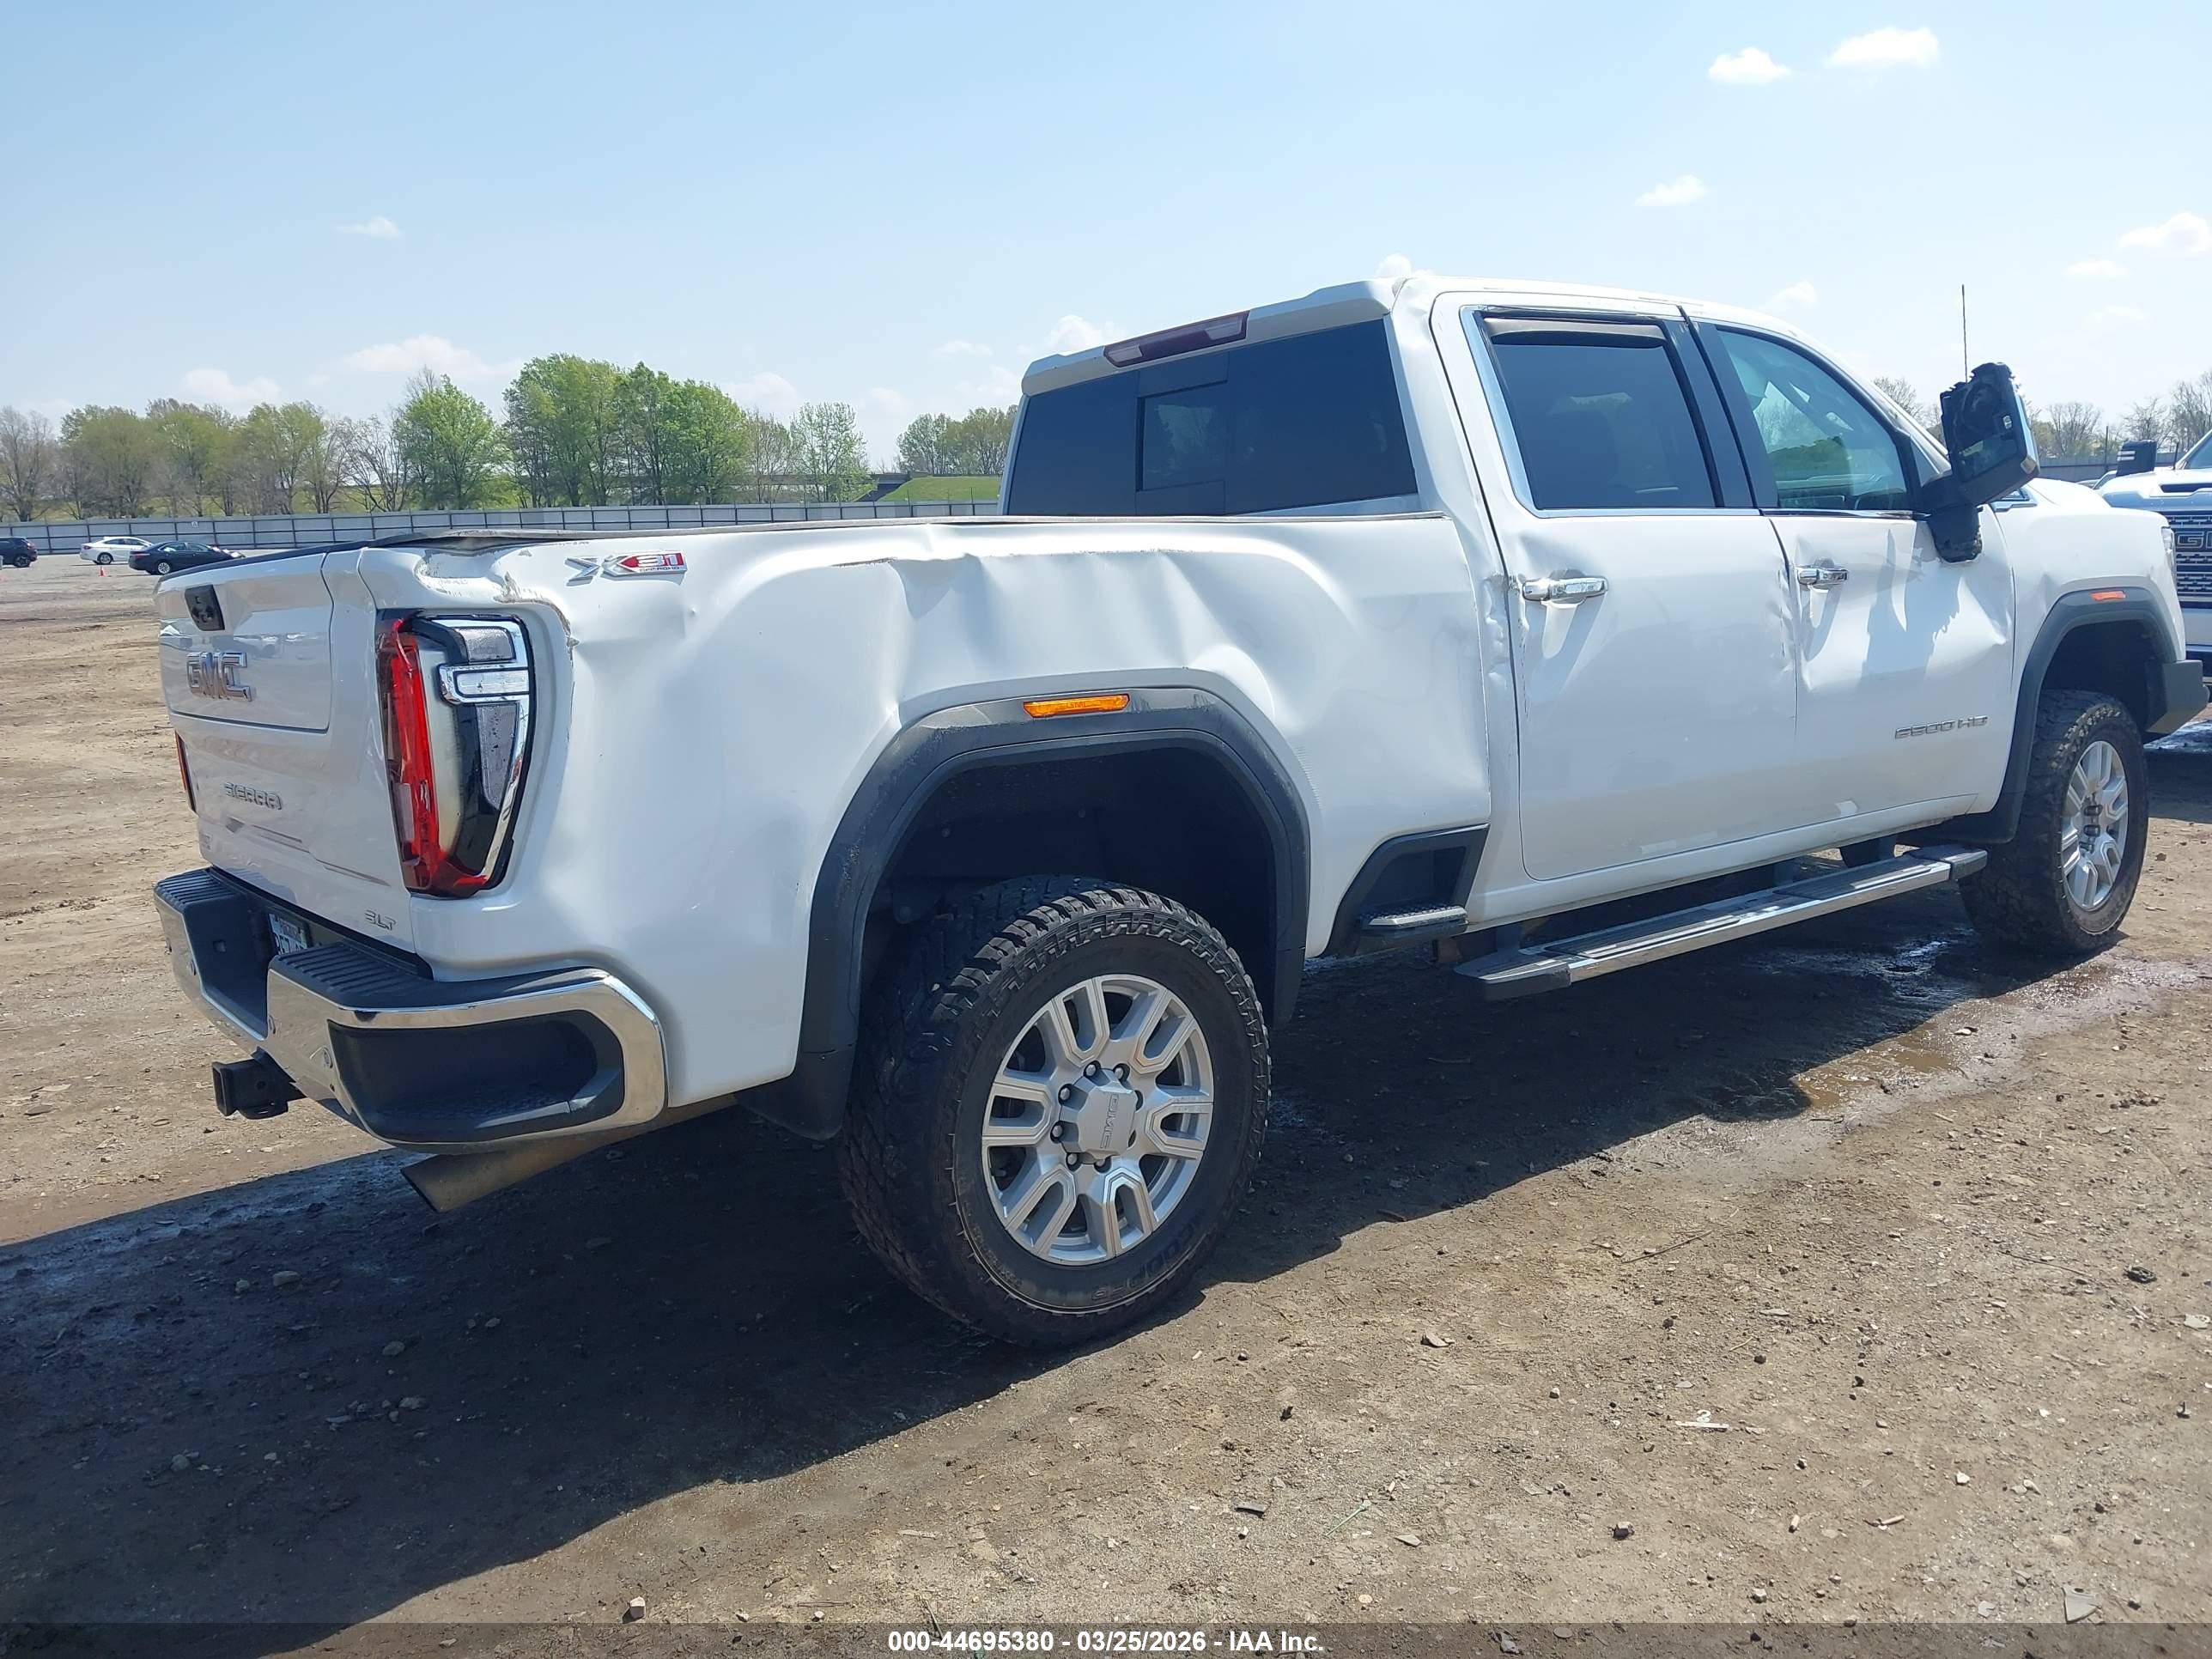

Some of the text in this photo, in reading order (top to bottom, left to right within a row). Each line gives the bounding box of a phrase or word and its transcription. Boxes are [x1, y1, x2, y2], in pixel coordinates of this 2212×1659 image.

[186, 652, 252, 702] GMC
[224, 781, 283, 811] SIERRA
[365, 908, 397, 931] SLT
[1100, 1094, 1120, 1149] GMC
